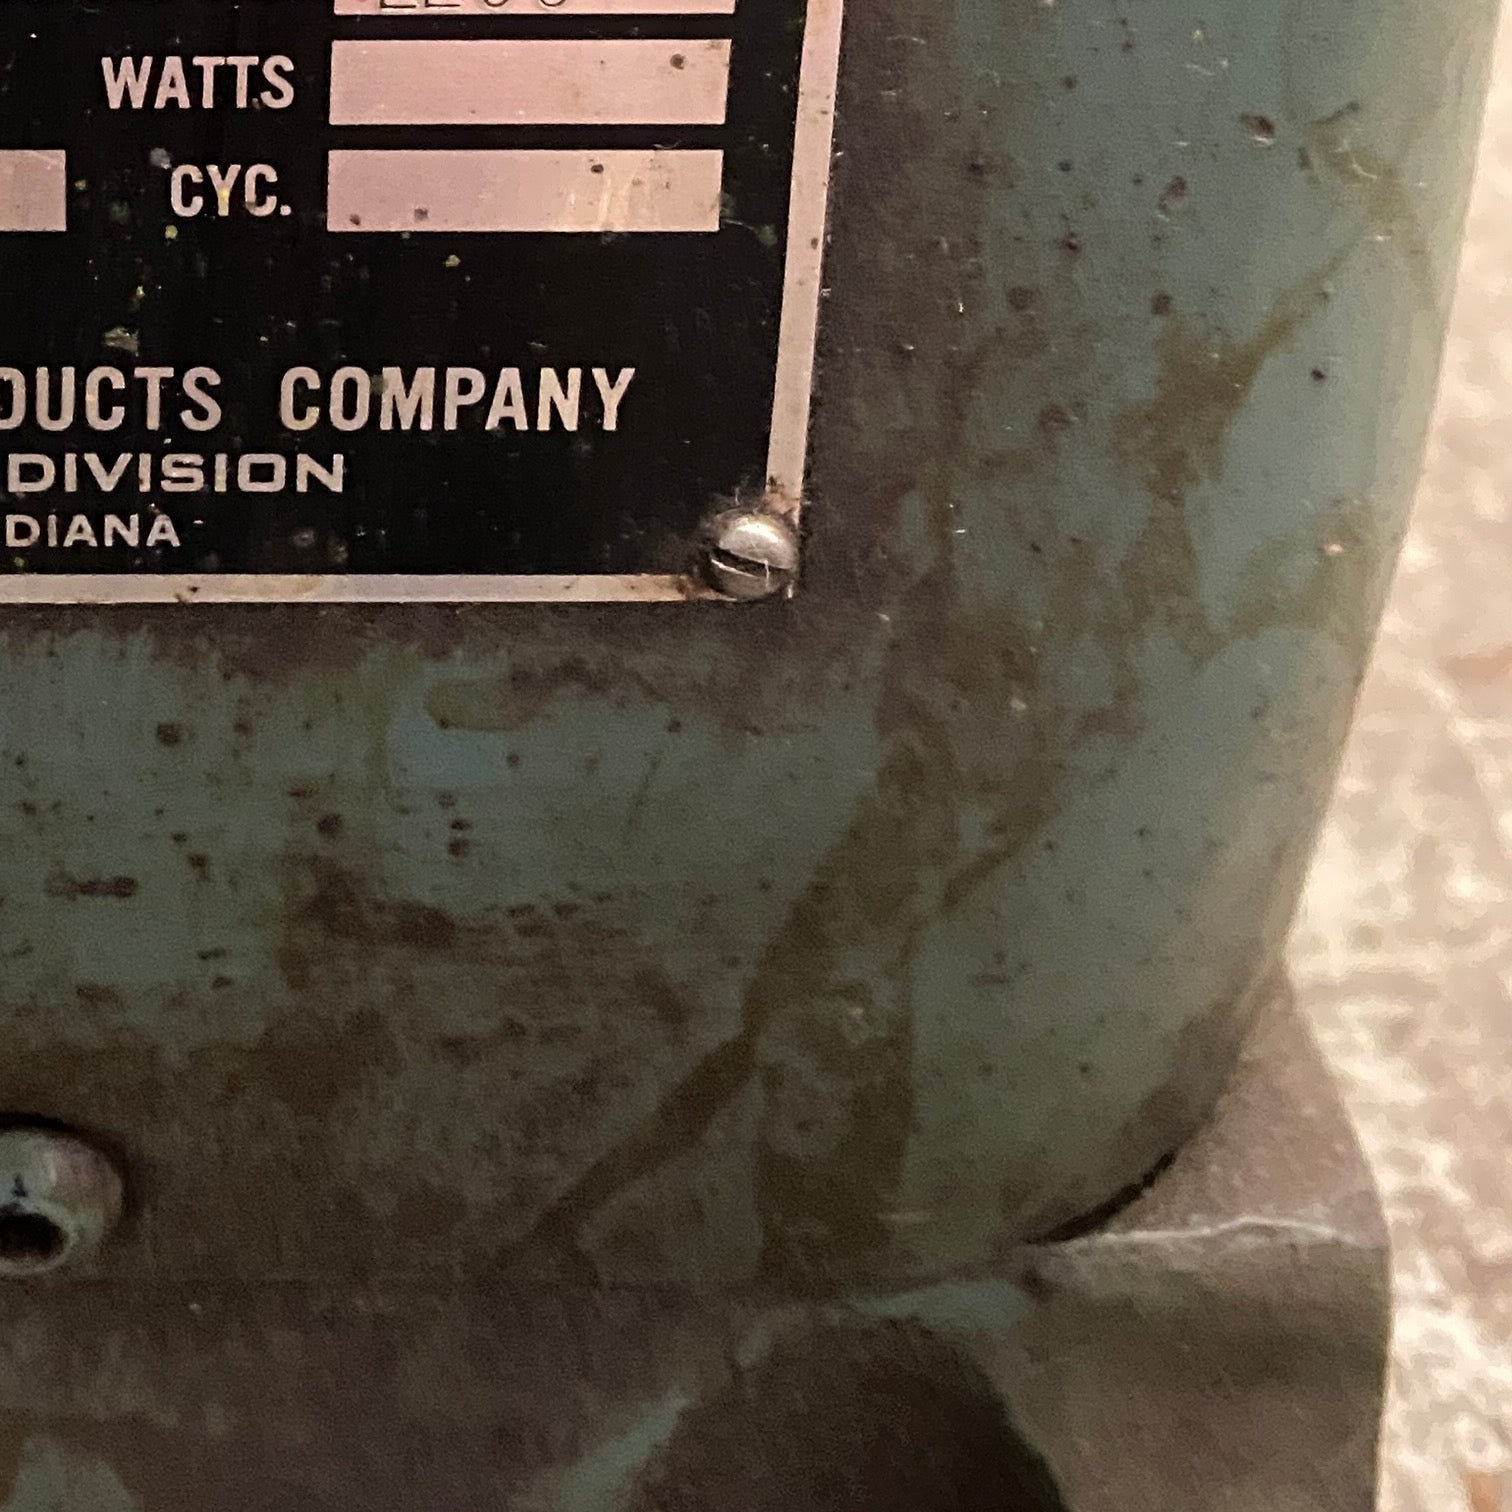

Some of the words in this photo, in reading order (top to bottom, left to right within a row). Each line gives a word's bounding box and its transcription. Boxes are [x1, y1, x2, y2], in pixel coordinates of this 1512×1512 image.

[101, 55, 295, 110] WATTS
[169, 163, 291, 218] CYC.
[279, 366, 636, 432] COMPANY
[7, 452, 344, 494] DIVISION
